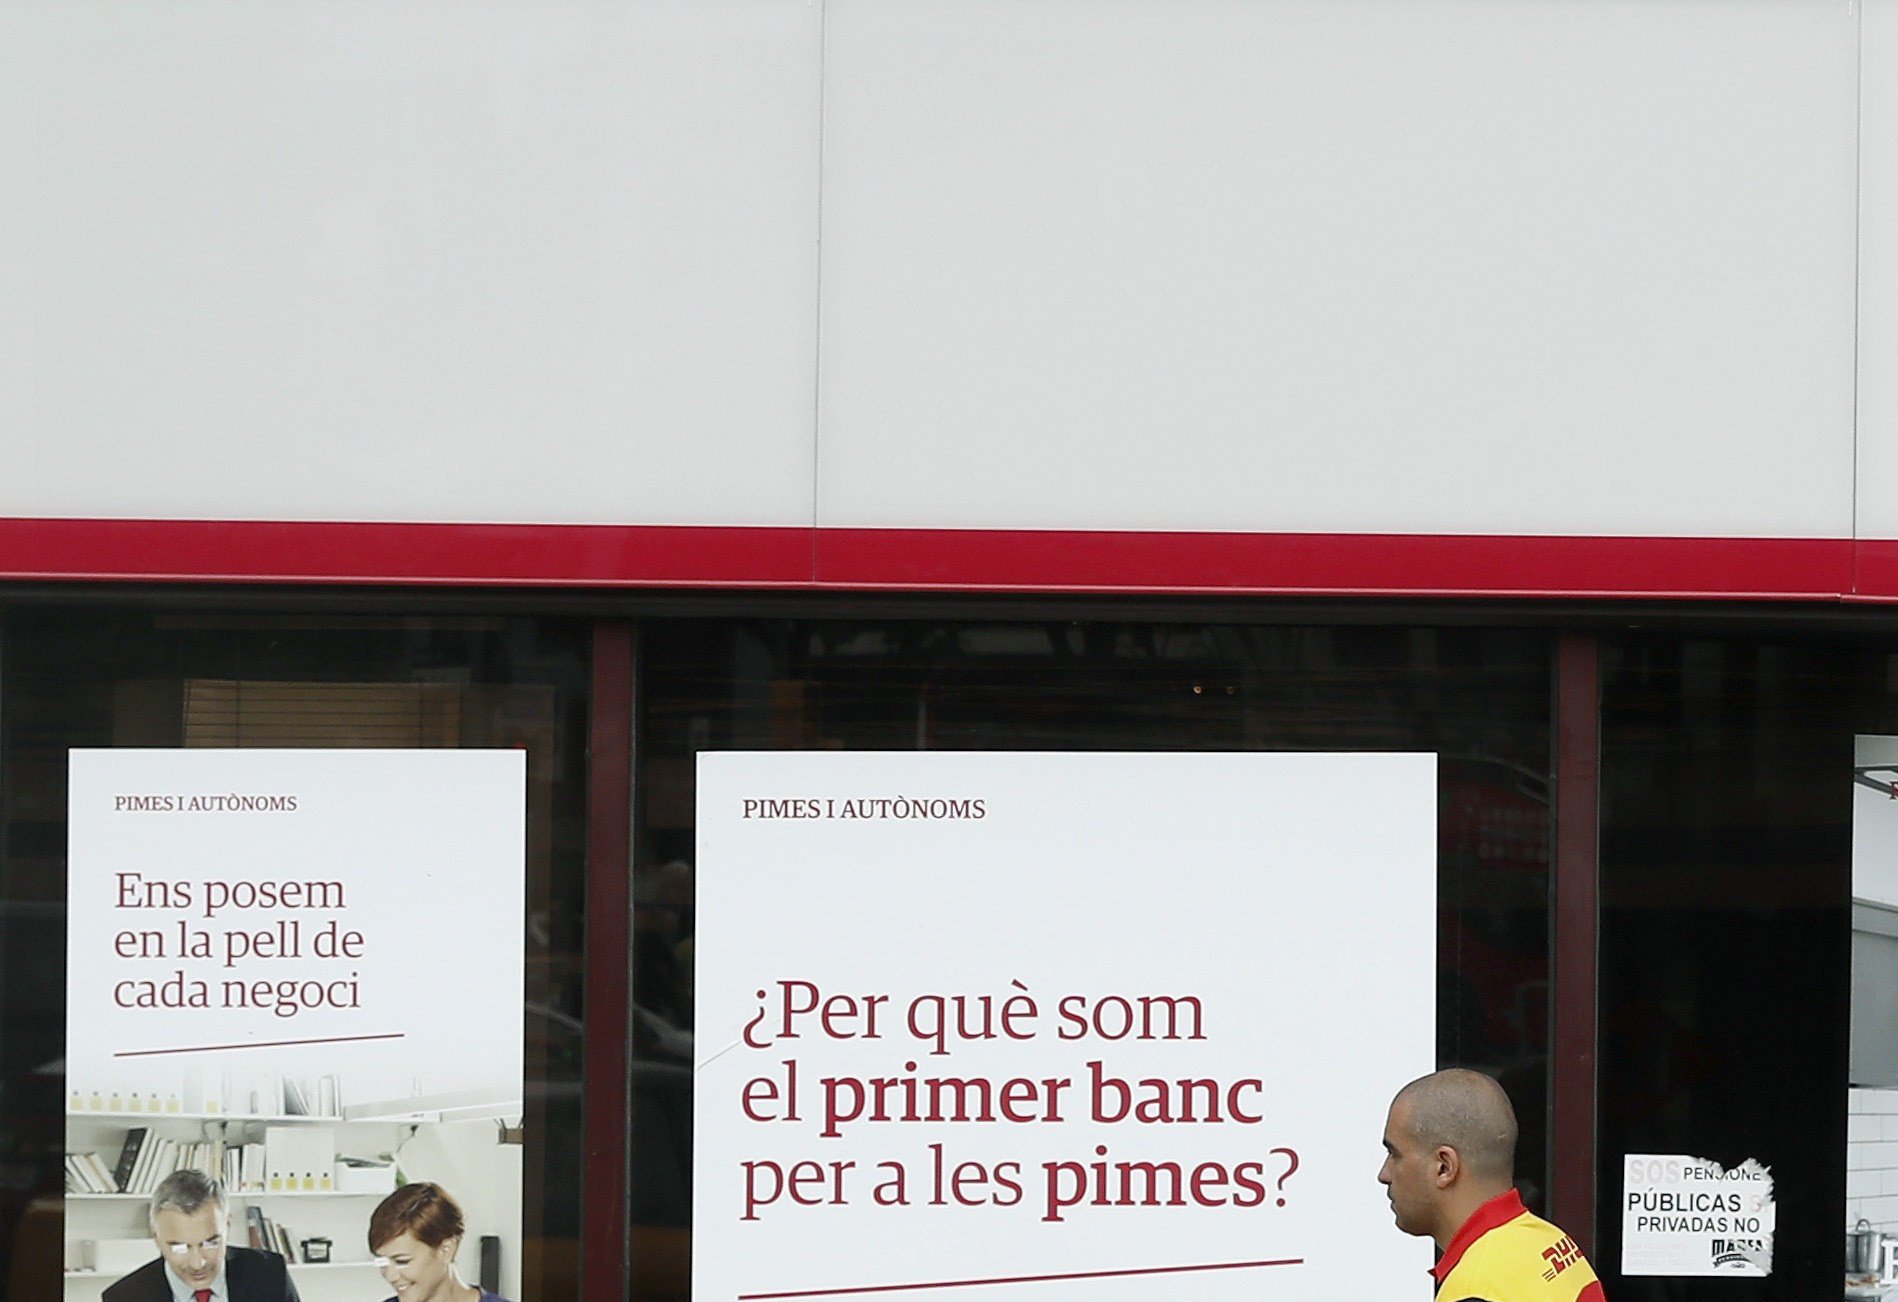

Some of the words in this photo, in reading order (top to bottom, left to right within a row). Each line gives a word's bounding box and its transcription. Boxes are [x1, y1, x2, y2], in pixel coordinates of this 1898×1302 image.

[115, 796, 173, 811] PIMES
[178, 796, 184, 811] I
[188, 793, 297, 811] AUTÒNOMS
[743, 799, 820, 818] PIMES
[827, 800, 835, 818] I
[840, 795, 985, 819] AUTÒNOMS
[115, 873, 191, 908] Ens
[203, 881, 346, 918] posem
[115, 931, 166, 958] en
[178, 921, 213, 958] la
[223, 920, 302, 968] pell
[314, 920, 364, 958] de
[114, 970, 210, 1008] cada
[222, 972, 360, 1017] negoci
[743, 981, 889, 1048] ¿Per
[908, 979, 1038, 1055] què
[1058, 996, 1207, 1040] som
[742, 1060, 802, 1122] el
[820, 1061, 1071, 1138] primer
[1086, 1060, 1262, 1124] banc
[740, 1161, 855, 1220] per
[873, 1162, 911, 1206] a
[928, 1143, 1023, 1206] les
[1042, 1145, 1299, 1222] pimes?
[1628, 1188, 1742, 1212] PÚBLICAS
[1637, 1217, 1728, 1232] PRIVADAS
[1734, 1218, 1761, 1233] NO
